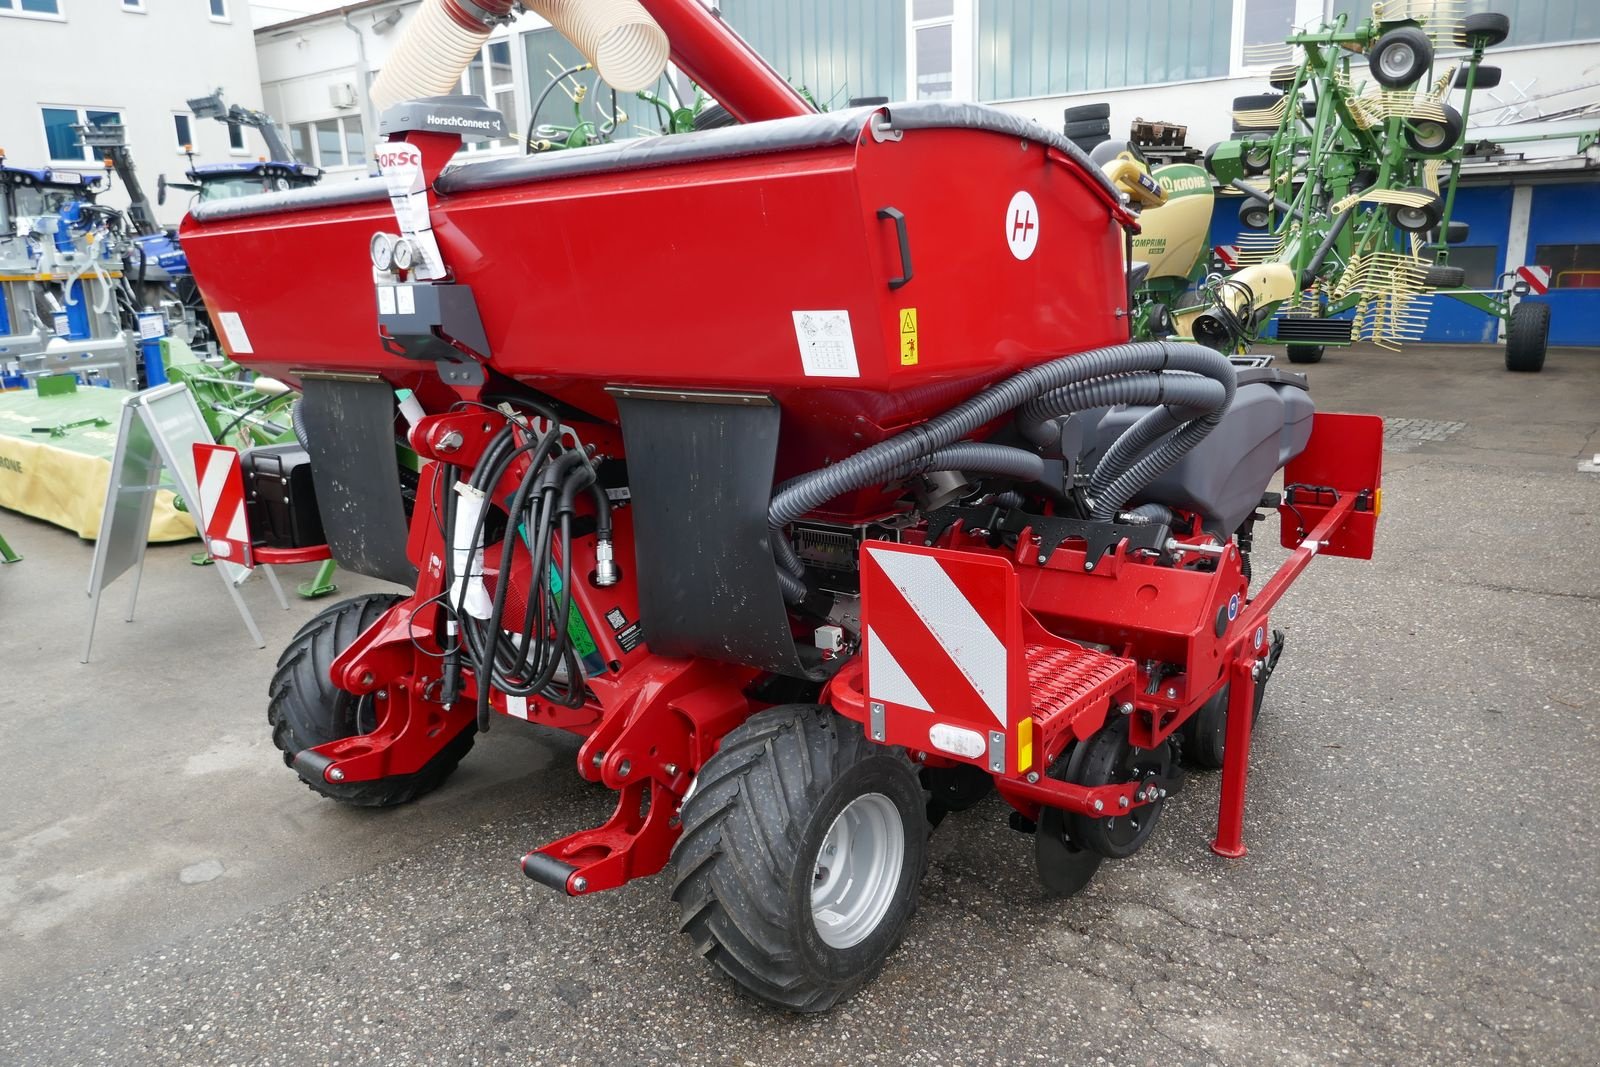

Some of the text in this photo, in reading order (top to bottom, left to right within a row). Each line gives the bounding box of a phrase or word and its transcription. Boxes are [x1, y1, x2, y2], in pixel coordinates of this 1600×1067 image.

[427, 115, 490, 129] HorschConnect
[378, 152, 418, 167] ORSC
[1173, 176, 1206, 192] KRONE
